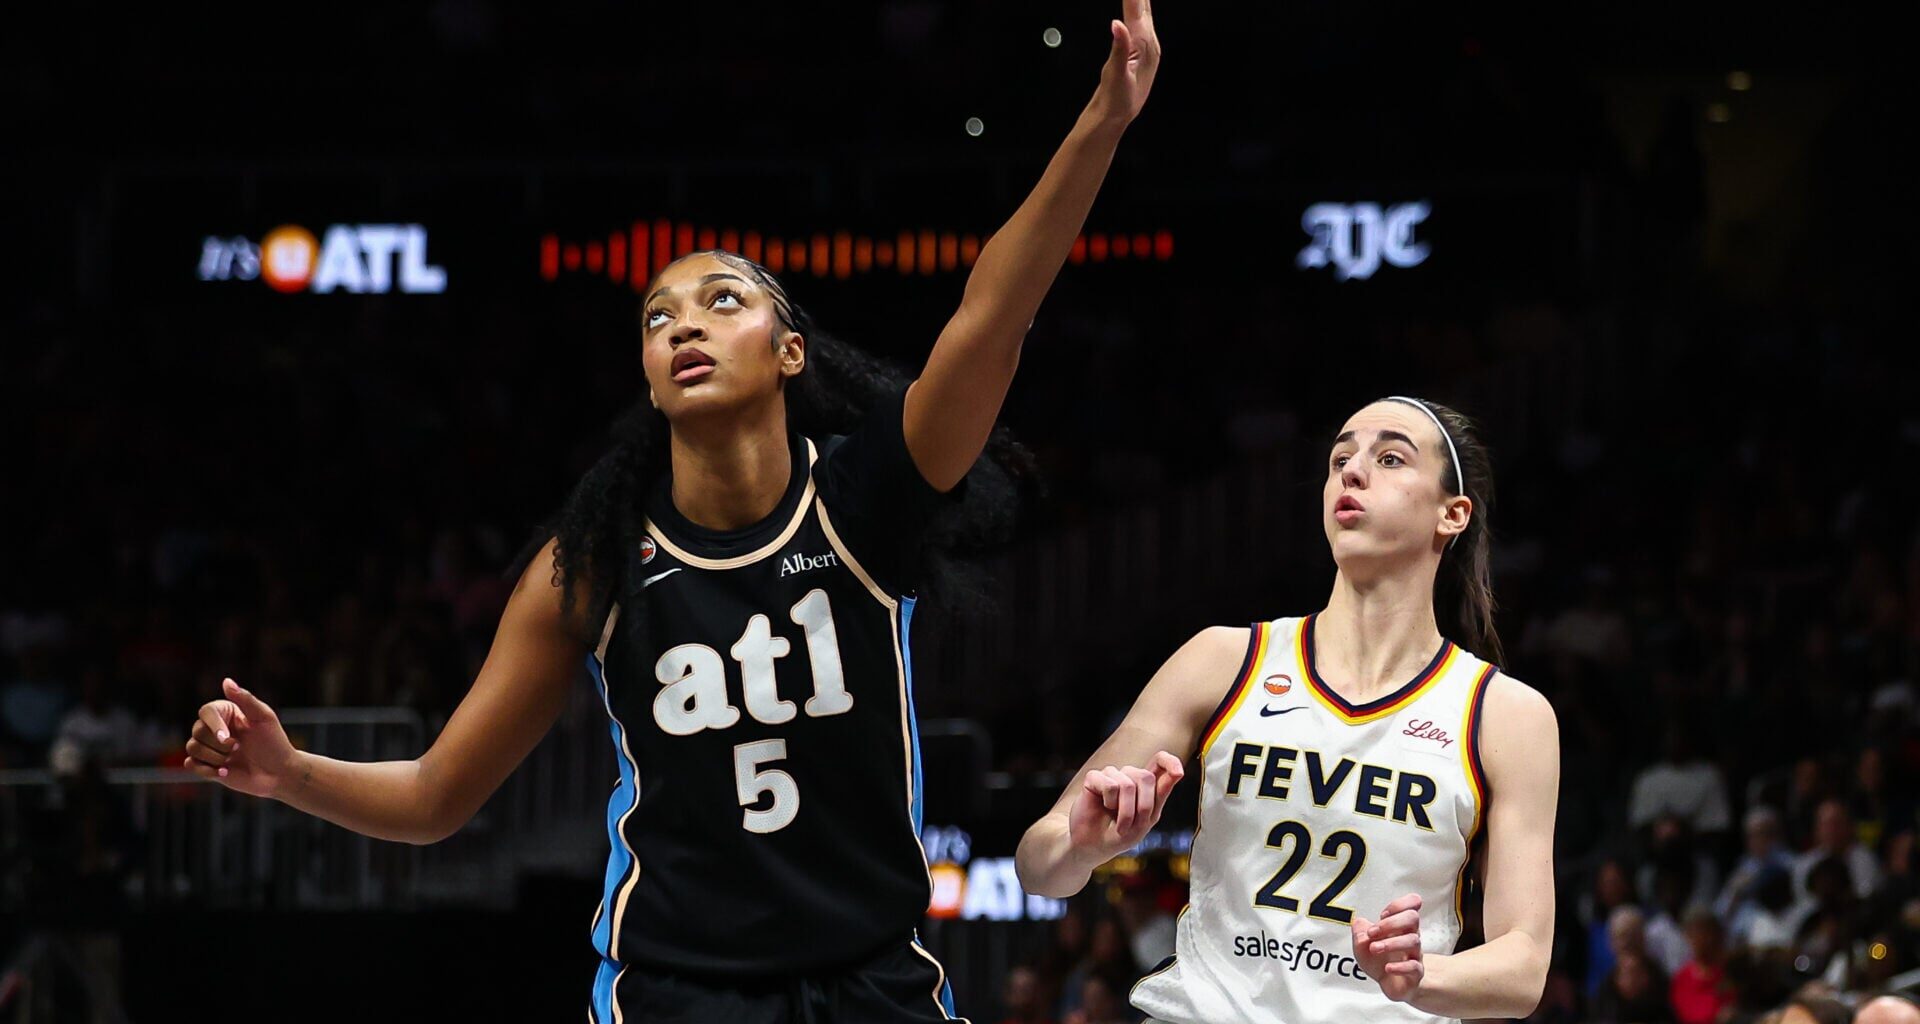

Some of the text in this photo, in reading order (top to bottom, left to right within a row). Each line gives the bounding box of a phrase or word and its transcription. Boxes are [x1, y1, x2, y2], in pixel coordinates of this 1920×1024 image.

[312, 223, 447, 293] ATL
[781, 551, 837, 577] Albert
[653, 589, 854, 735] atl
[1403, 719, 1454, 748] Lilly
[734, 739, 800, 833] 5
[1225, 741, 1437, 832] FEVER
[1253, 820, 1368, 926] 22
[1234, 930, 1367, 981] salesforce
